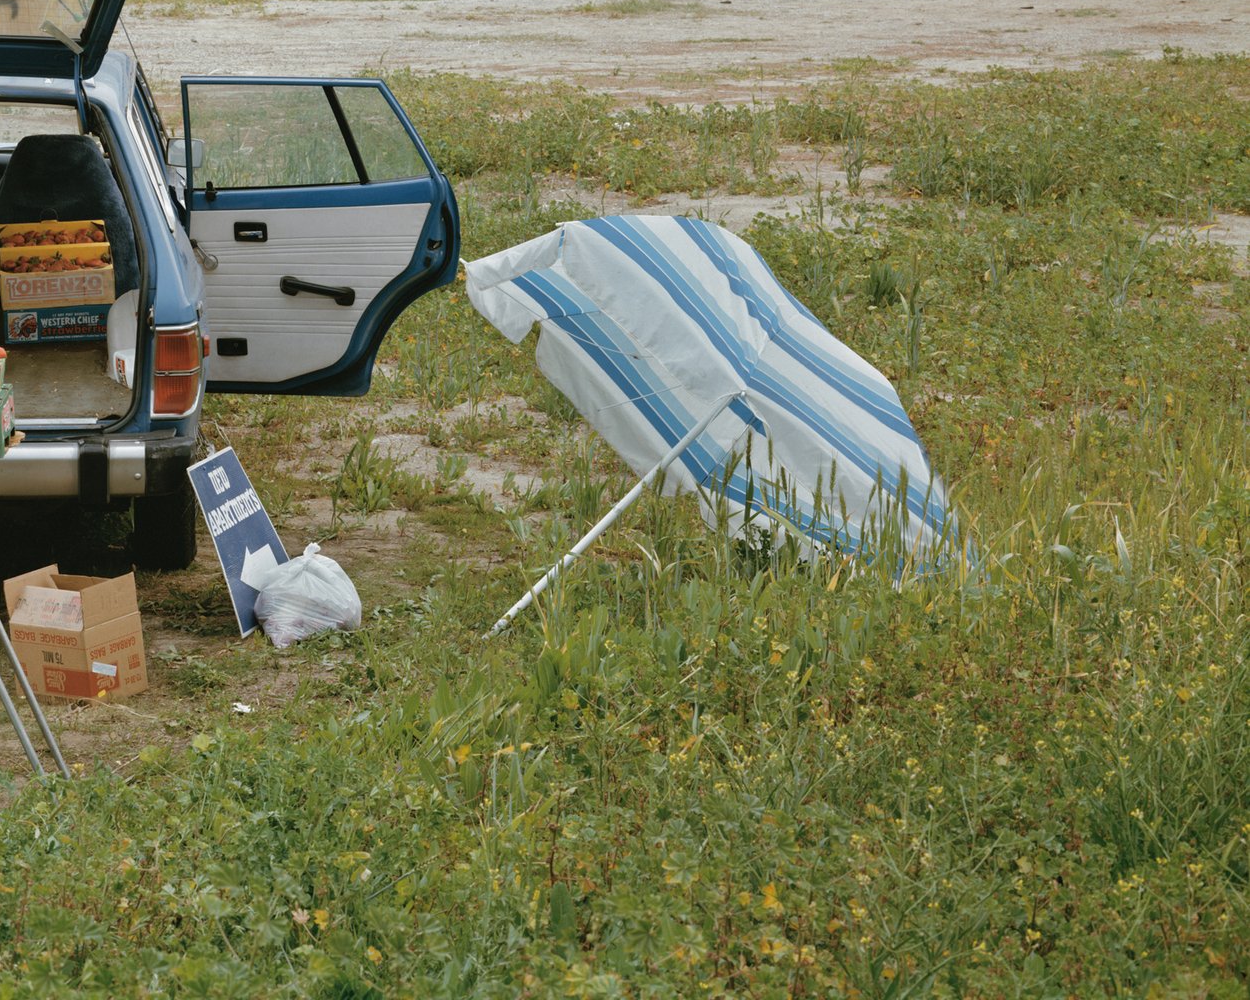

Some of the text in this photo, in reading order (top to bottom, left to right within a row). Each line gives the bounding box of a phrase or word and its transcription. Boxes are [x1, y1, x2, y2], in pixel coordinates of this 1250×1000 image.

[5, 274, 104, 300] LORENZO
[40, 315, 99, 328] WESTERN CHIEF
[207, 465, 231, 495] NEW
[14, 630, 78, 647] GARBAGE BAGS
[89, 636, 136, 660] GARBAGE BAGS
